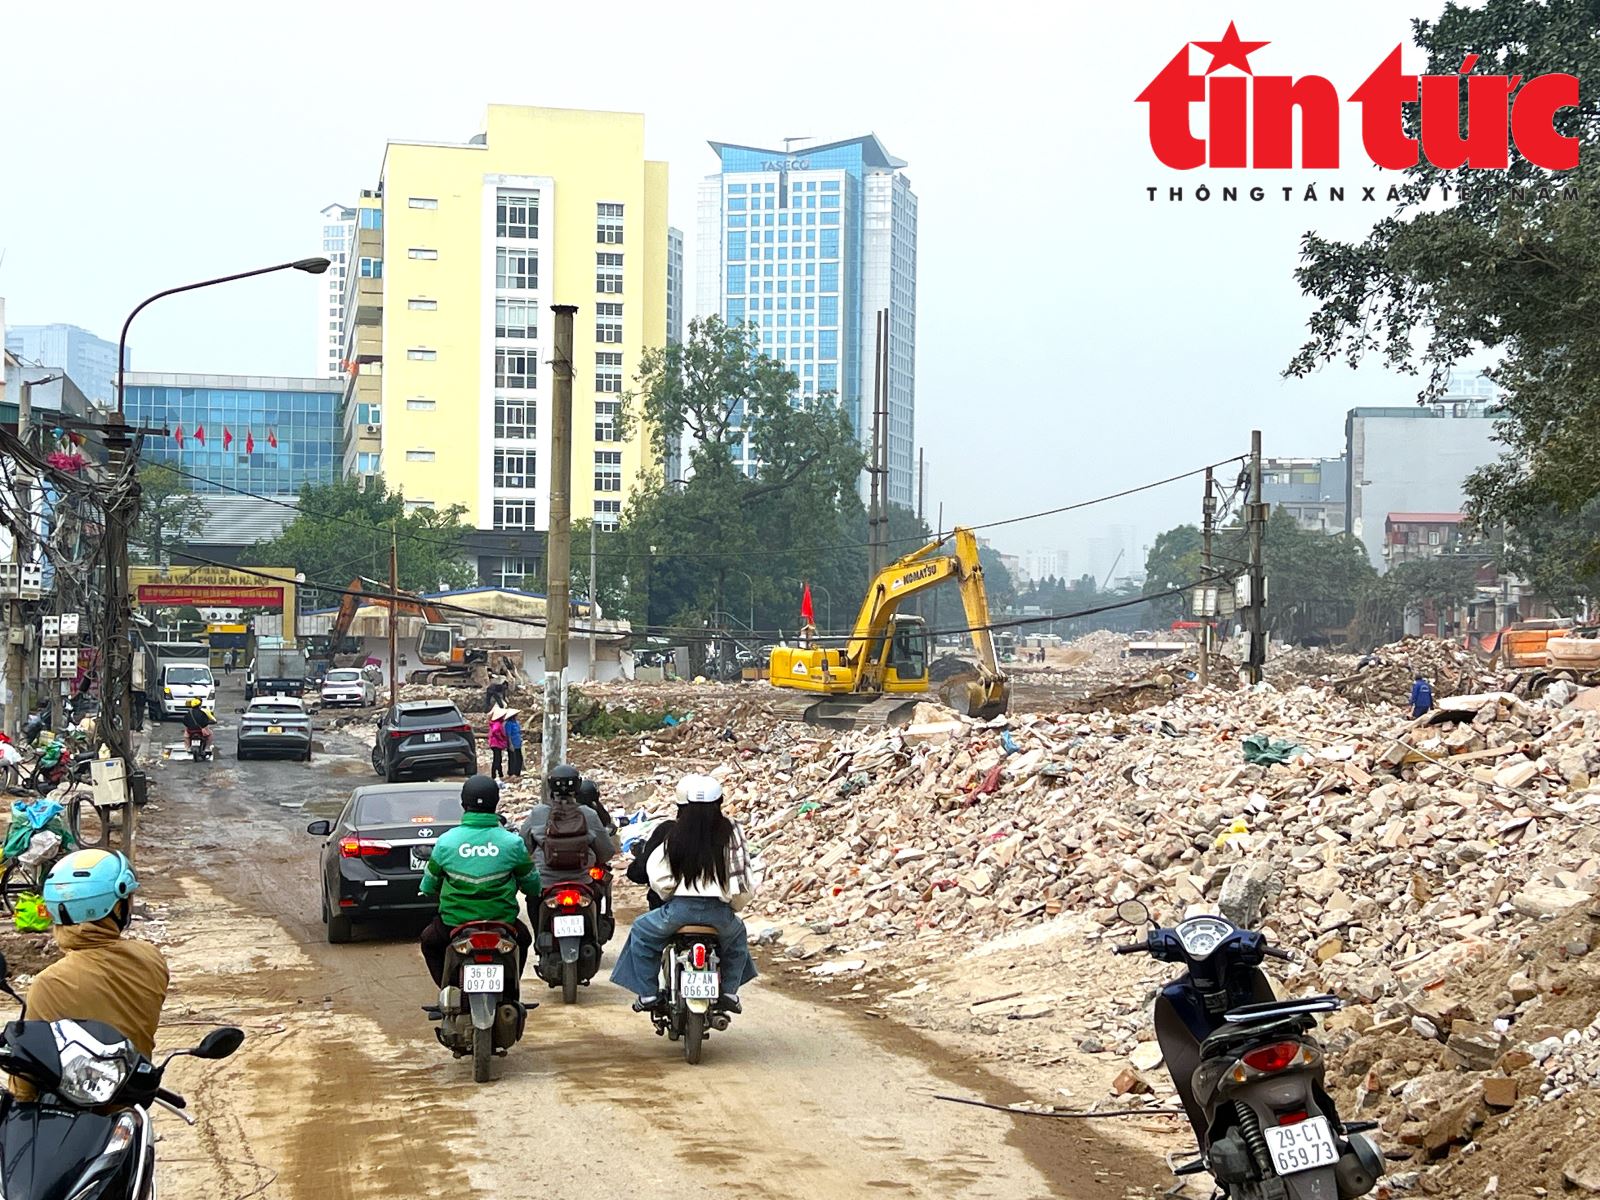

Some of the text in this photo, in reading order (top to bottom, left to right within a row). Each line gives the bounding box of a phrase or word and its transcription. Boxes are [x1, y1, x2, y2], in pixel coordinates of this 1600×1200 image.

[760, 159, 810, 172] TASECO
[903, 564, 937, 585] KOMATSU
[458, 842, 500, 858] Grab
[1275, 1122, 1321, 1149] 29-C1
[1277, 1141, 1334, 1171] 659.73
